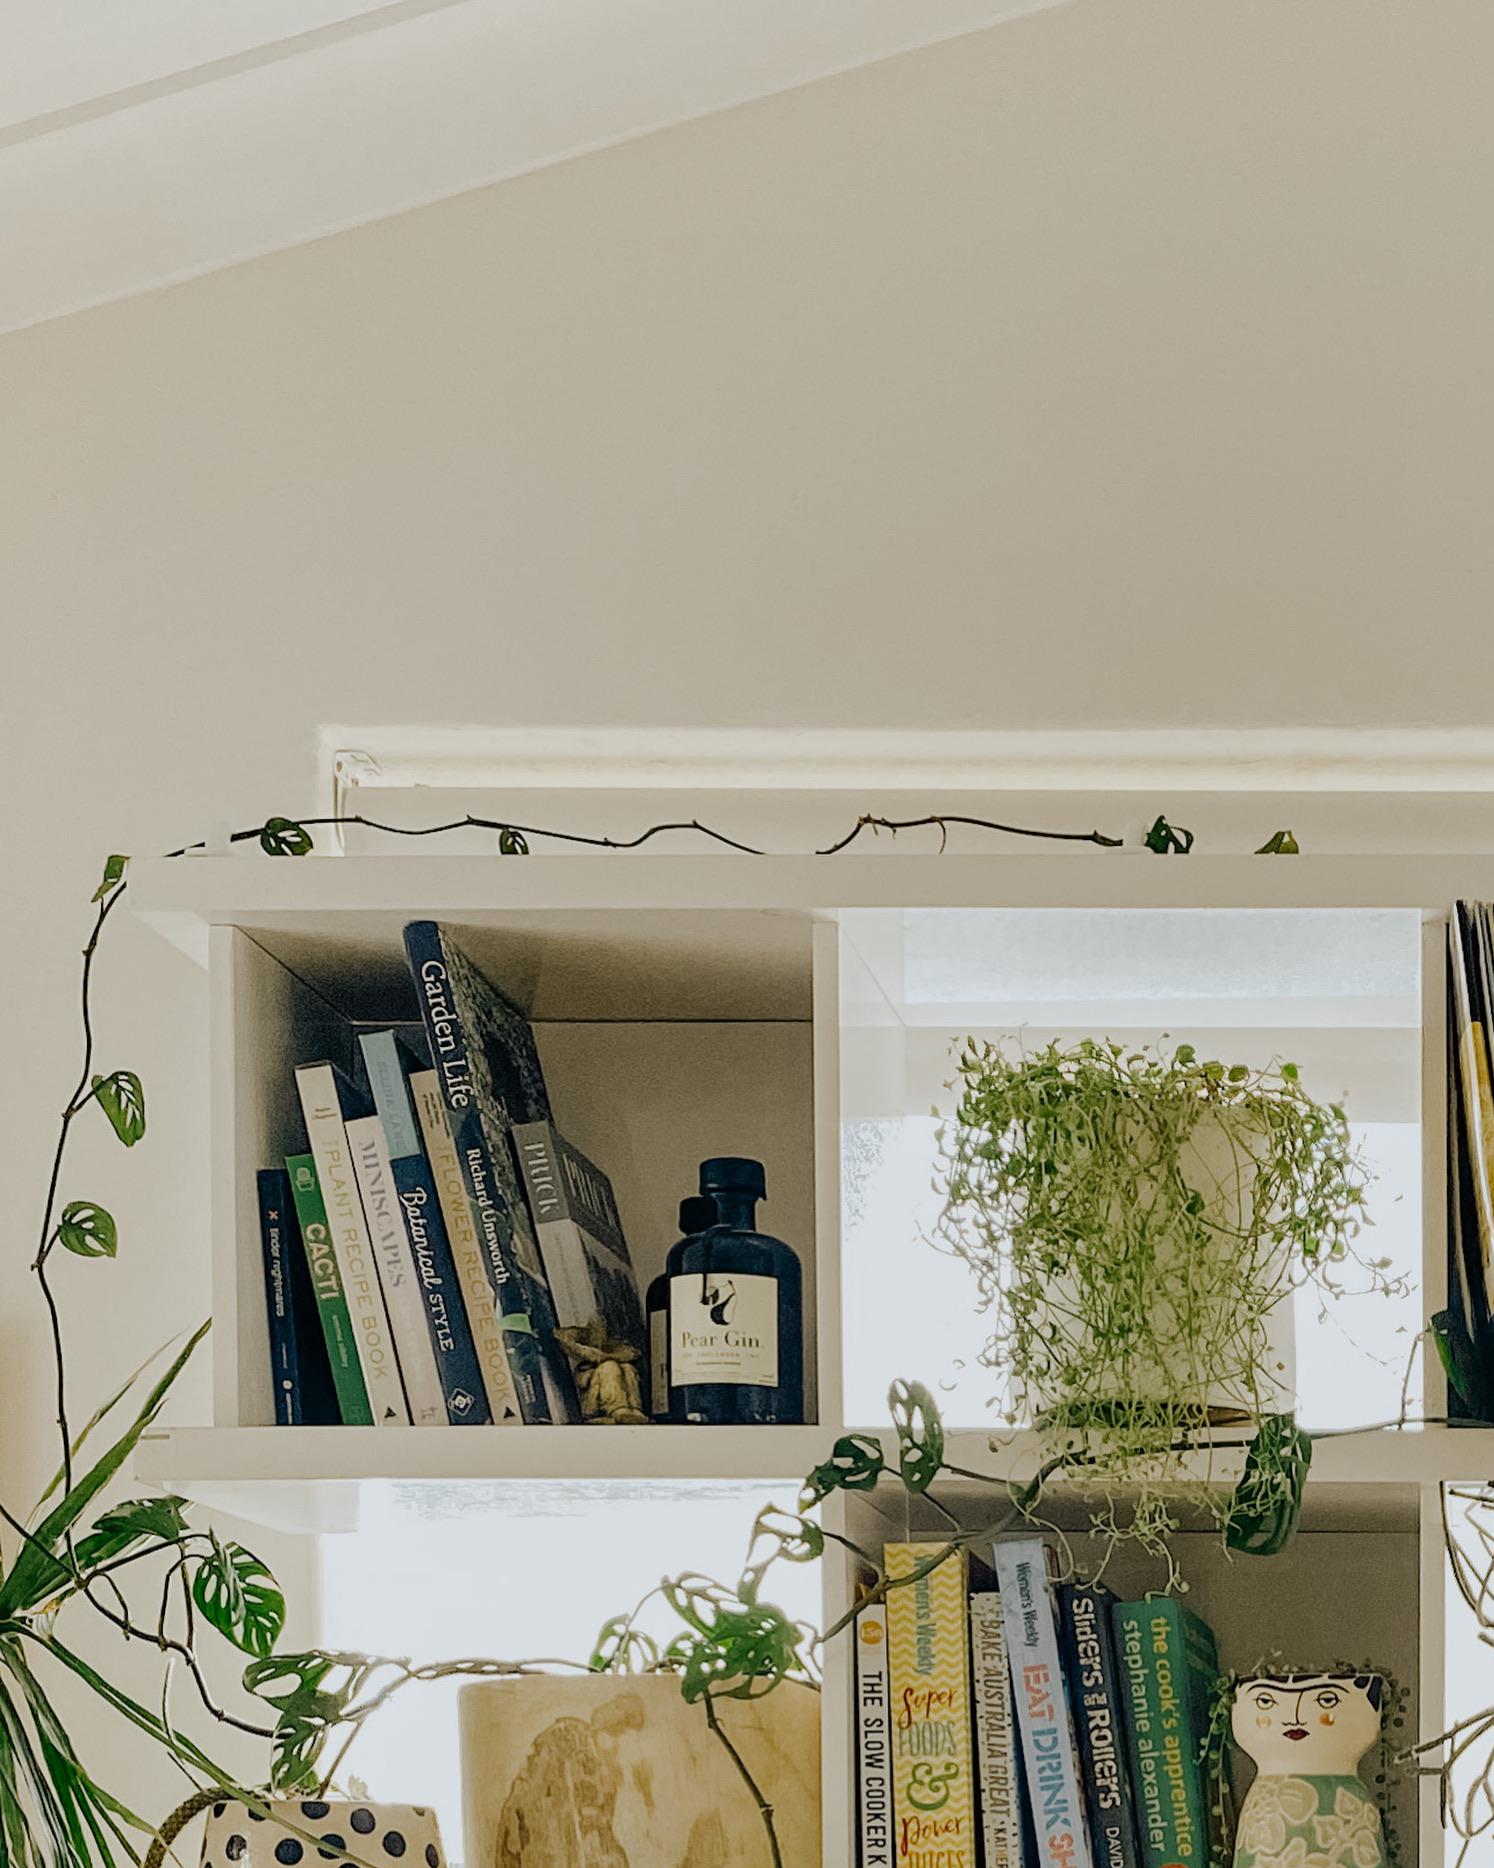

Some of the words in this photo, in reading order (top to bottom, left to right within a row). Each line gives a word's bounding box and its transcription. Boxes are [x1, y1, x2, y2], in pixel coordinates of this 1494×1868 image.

[421, 960, 458, 1054] Garden
[443, 1059, 474, 1109] Life
[359, 1139, 407, 1288] MINISCAPES
[524, 1143, 560, 1214] PRICK
[467, 1148, 493, 1207] Richard
[481, 1209, 511, 1284] Unsworth
[306, 1223, 339, 1299] CACTI
[327, 1150, 354, 1221] PLANT
[343, 1230, 374, 1308] RECIPE
[362, 1316, 389, 1378] BOOK
[400, 1187, 443, 1288] Botanical
[429, 1294, 454, 1351] STYLE
[440, 1154, 473, 1243] FLOWER
[467, 1252, 494, 1330] RECIPE
[485, 1339, 509, 1399] BOOK
[682, 1332, 717, 1348] Pear
[1014, 1561, 1036, 1609] Women's
[911, 1624, 936, 1675] Weekly
[978, 1619, 1001, 1662] BAKE
[1019, 1609, 1042, 1648] Weekly
[1149, 1615, 1171, 1654] the
[861, 1672, 882, 1707] THE
[898, 1687, 956, 1730] Super
[1021, 1662, 1055, 1723] EAT
[1117, 1618, 1155, 1732] stephanie
[1153, 1656, 1181, 1730] cook's
[862, 1717, 884, 1770] SLOW
[899, 1720, 957, 1757] FOODS
[981, 1666, 1008, 1759] AUSTRALIA
[863, 1776, 886, 1848] COOKER
[906, 1762, 959, 1811] &
[986, 1766, 1011, 1817] GREAT
[1031, 1726, 1071, 1832] DRINK
[1134, 1736, 1172, 1853] alexander
[1158, 1732, 1197, 1858] apprentice
